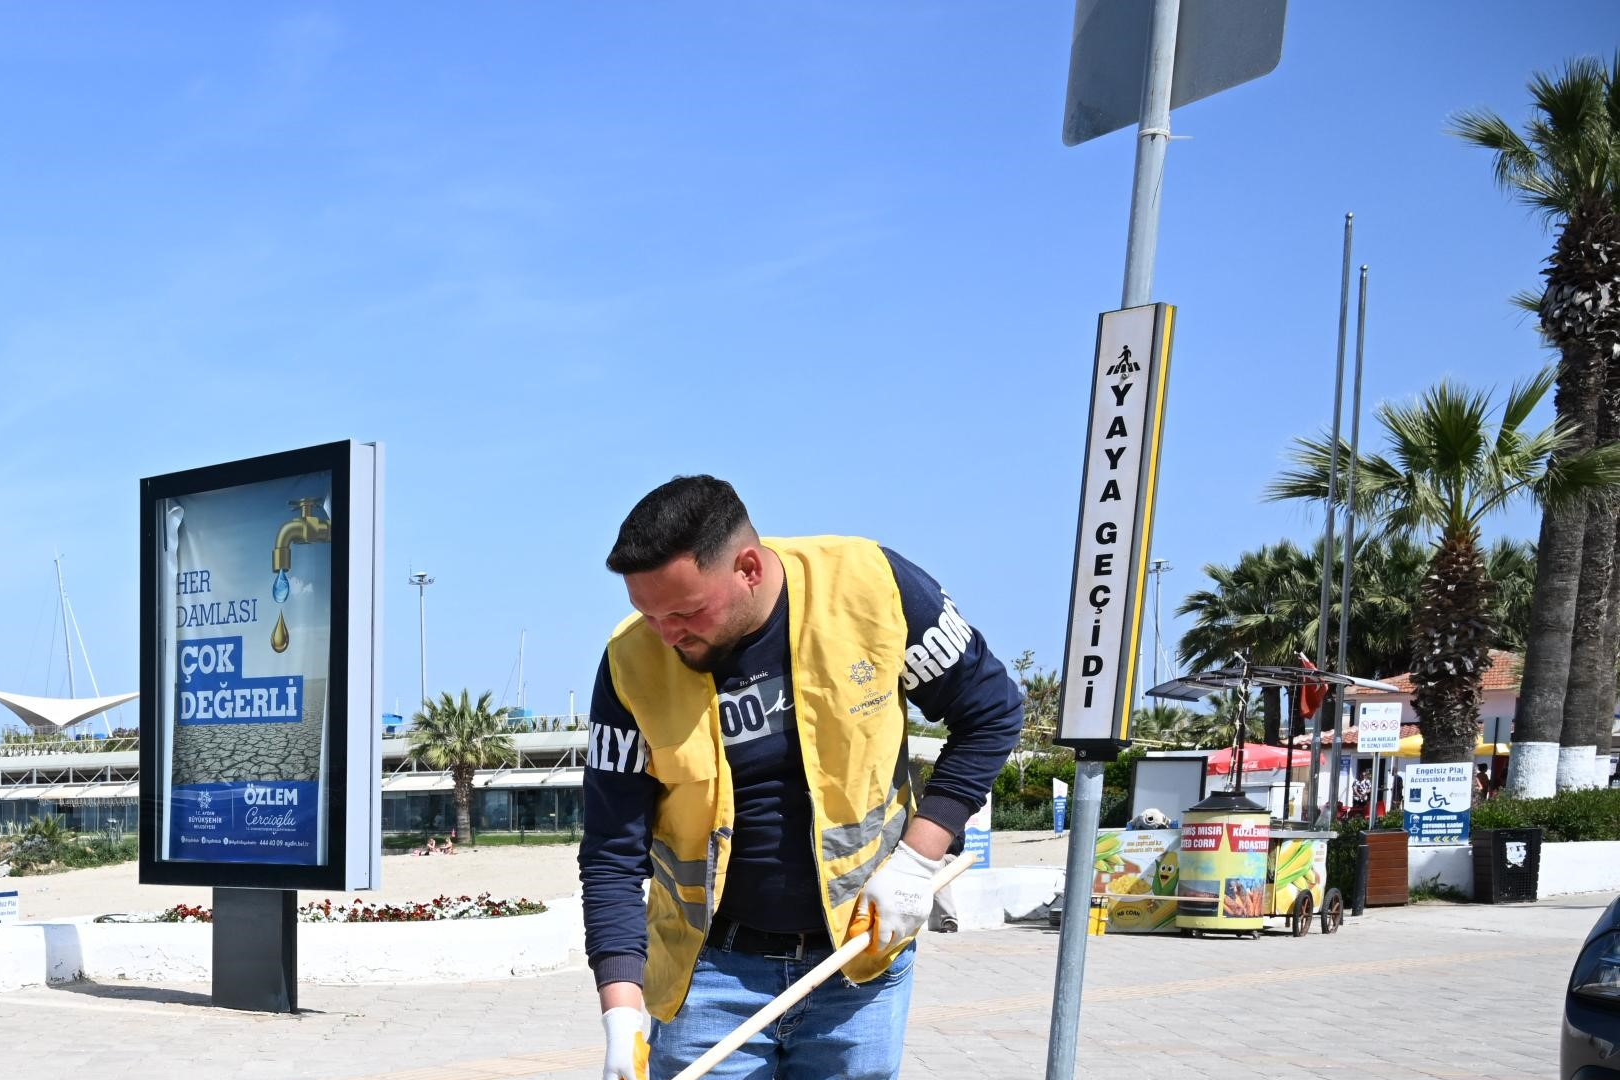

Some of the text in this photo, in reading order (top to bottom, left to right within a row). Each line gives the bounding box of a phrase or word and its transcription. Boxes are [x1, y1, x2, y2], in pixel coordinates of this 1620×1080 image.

[1082, 384, 1133, 709] YAYA GEÇİDİ
[176, 570, 211, 595] HER
[176, 599, 258, 628] DAMLASI
[181, 643, 235, 684] ÇOK
[749, 670, 769, 683] Music
[181, 678, 297, 720] DEĞERLİ
[1416, 766, 1464, 775] Engelsiz Plaj
[244, 783, 298, 806] ÖZLEM
[188, 815, 223, 824] BÜYÜKŞEHİR
[1193, 839, 1216, 848] CORN
